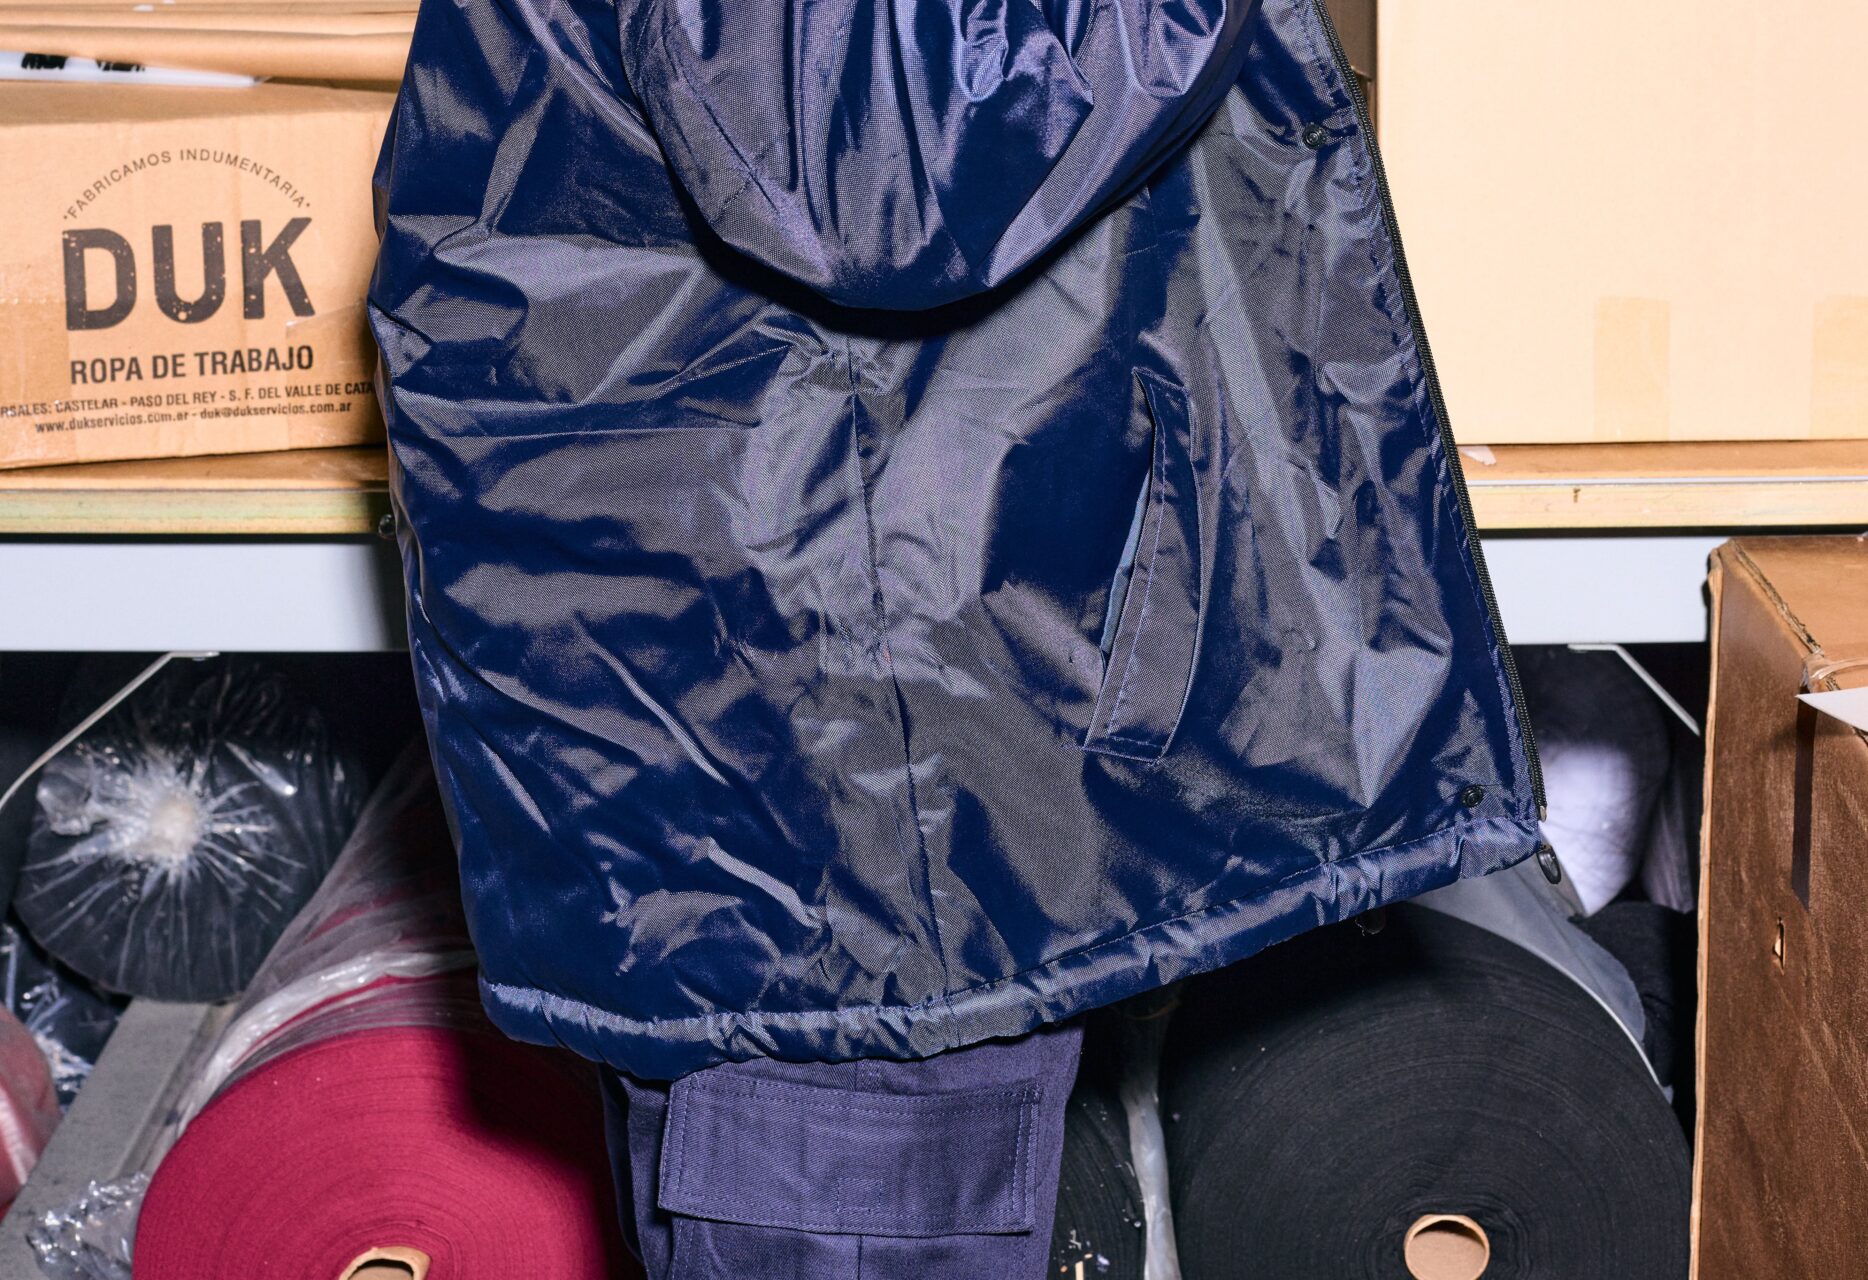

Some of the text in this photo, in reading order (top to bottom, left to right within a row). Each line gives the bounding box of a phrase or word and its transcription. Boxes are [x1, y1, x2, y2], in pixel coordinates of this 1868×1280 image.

[62, 217, 316, 331] DUK
[71, 345, 313, 384] ROPA DE TRABAJO
[56, 398, 118, 413] CASTELAR
[130, 395, 162, 407] PASO
[166, 394, 189, 406] DEL
[193, 391, 217, 404] REY
[258, 387, 281, 399] DEL
[285, 384, 321, 398] VALLE
[325, 384, 341, 395] DE
